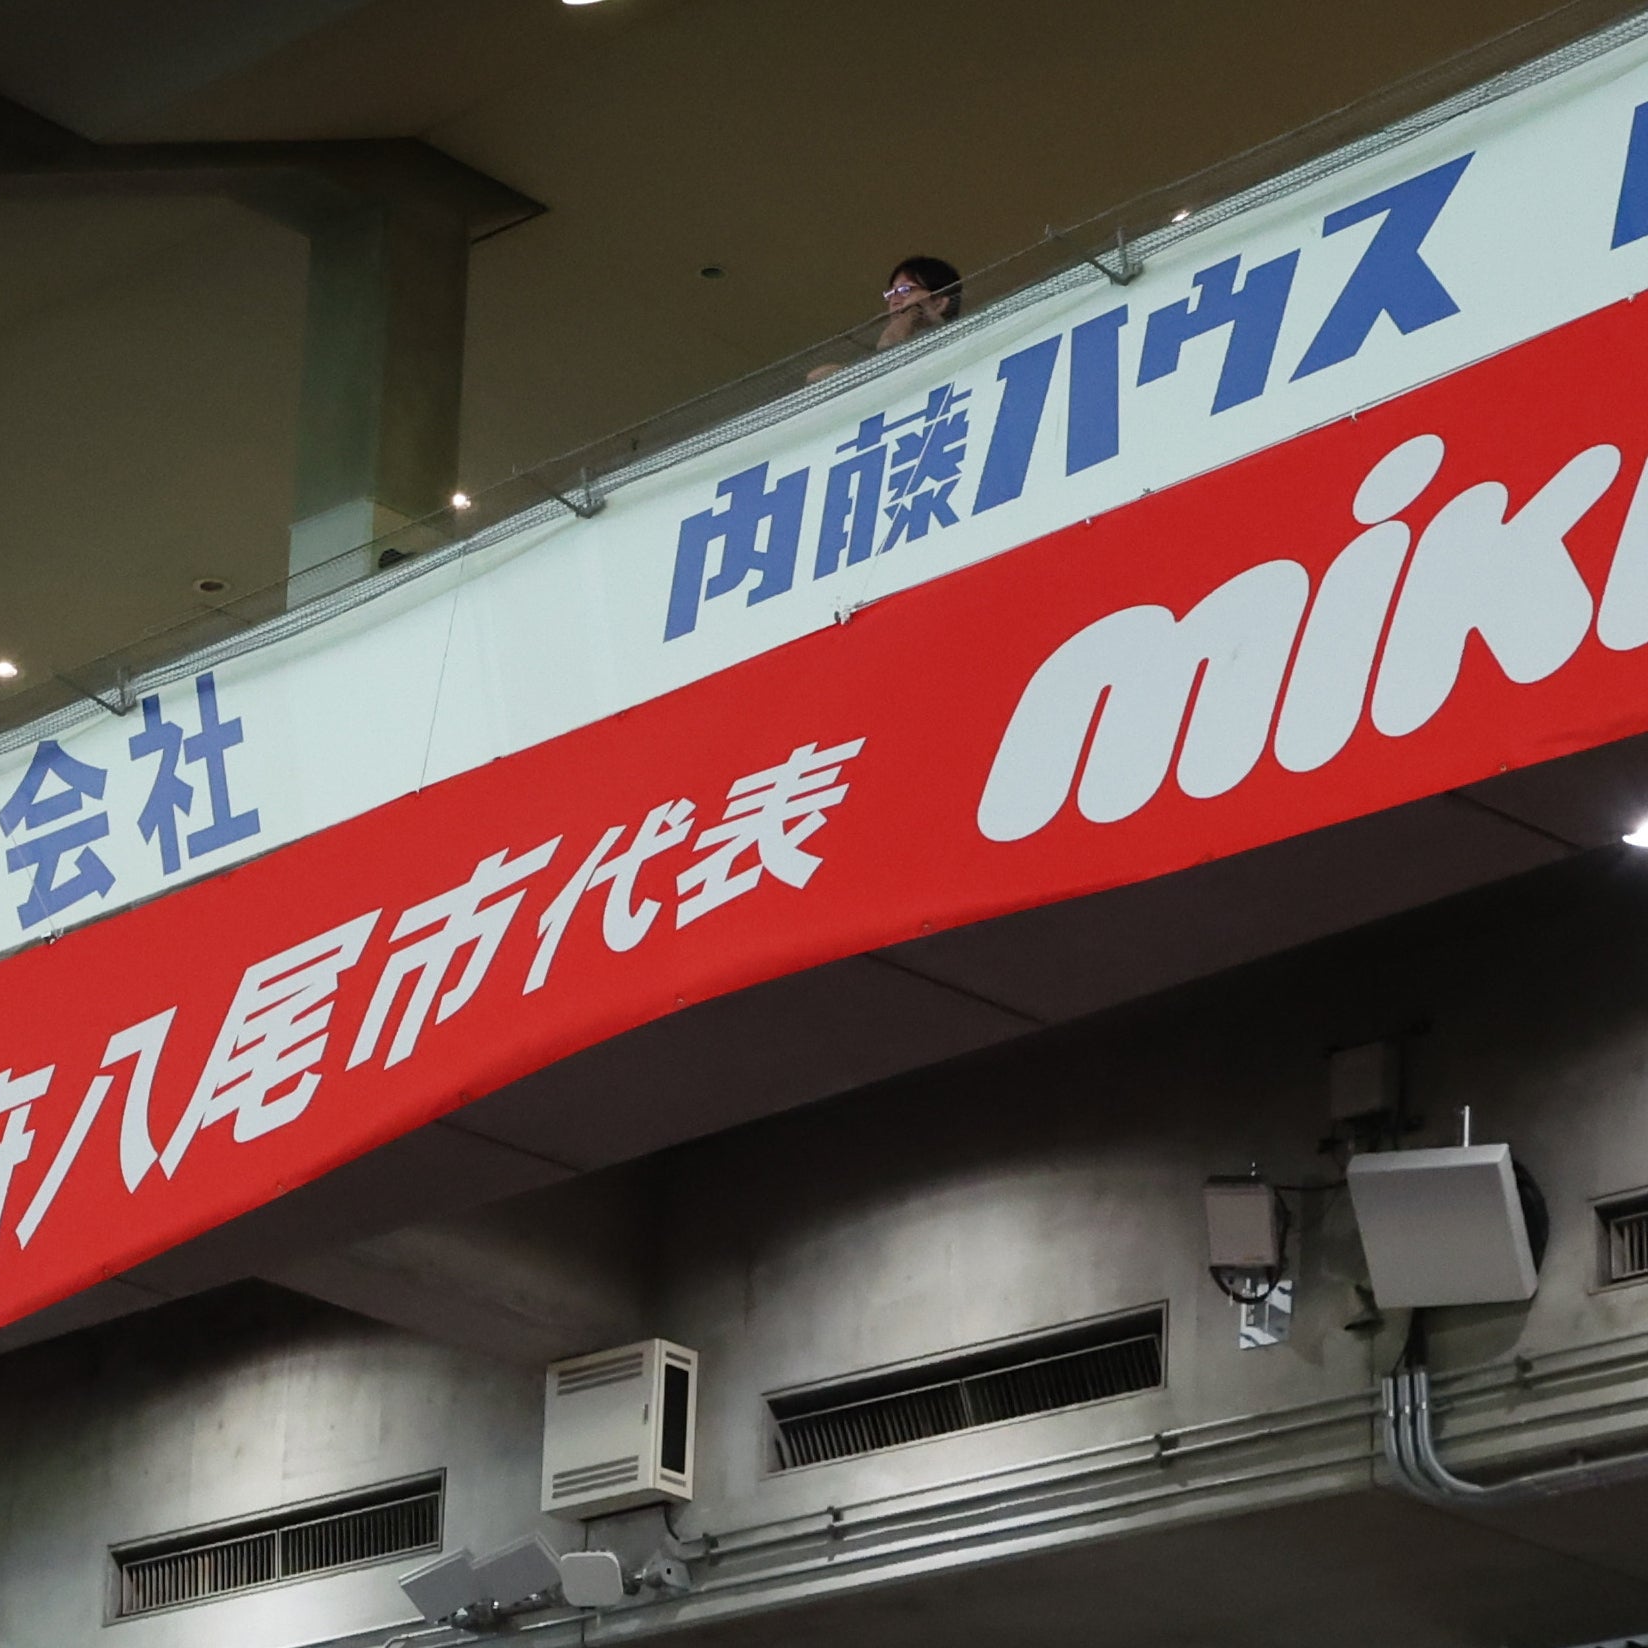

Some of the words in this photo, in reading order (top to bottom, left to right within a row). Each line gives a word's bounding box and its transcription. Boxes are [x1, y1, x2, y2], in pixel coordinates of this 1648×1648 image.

[663, 151, 1475, 643] 内藤ハウス
